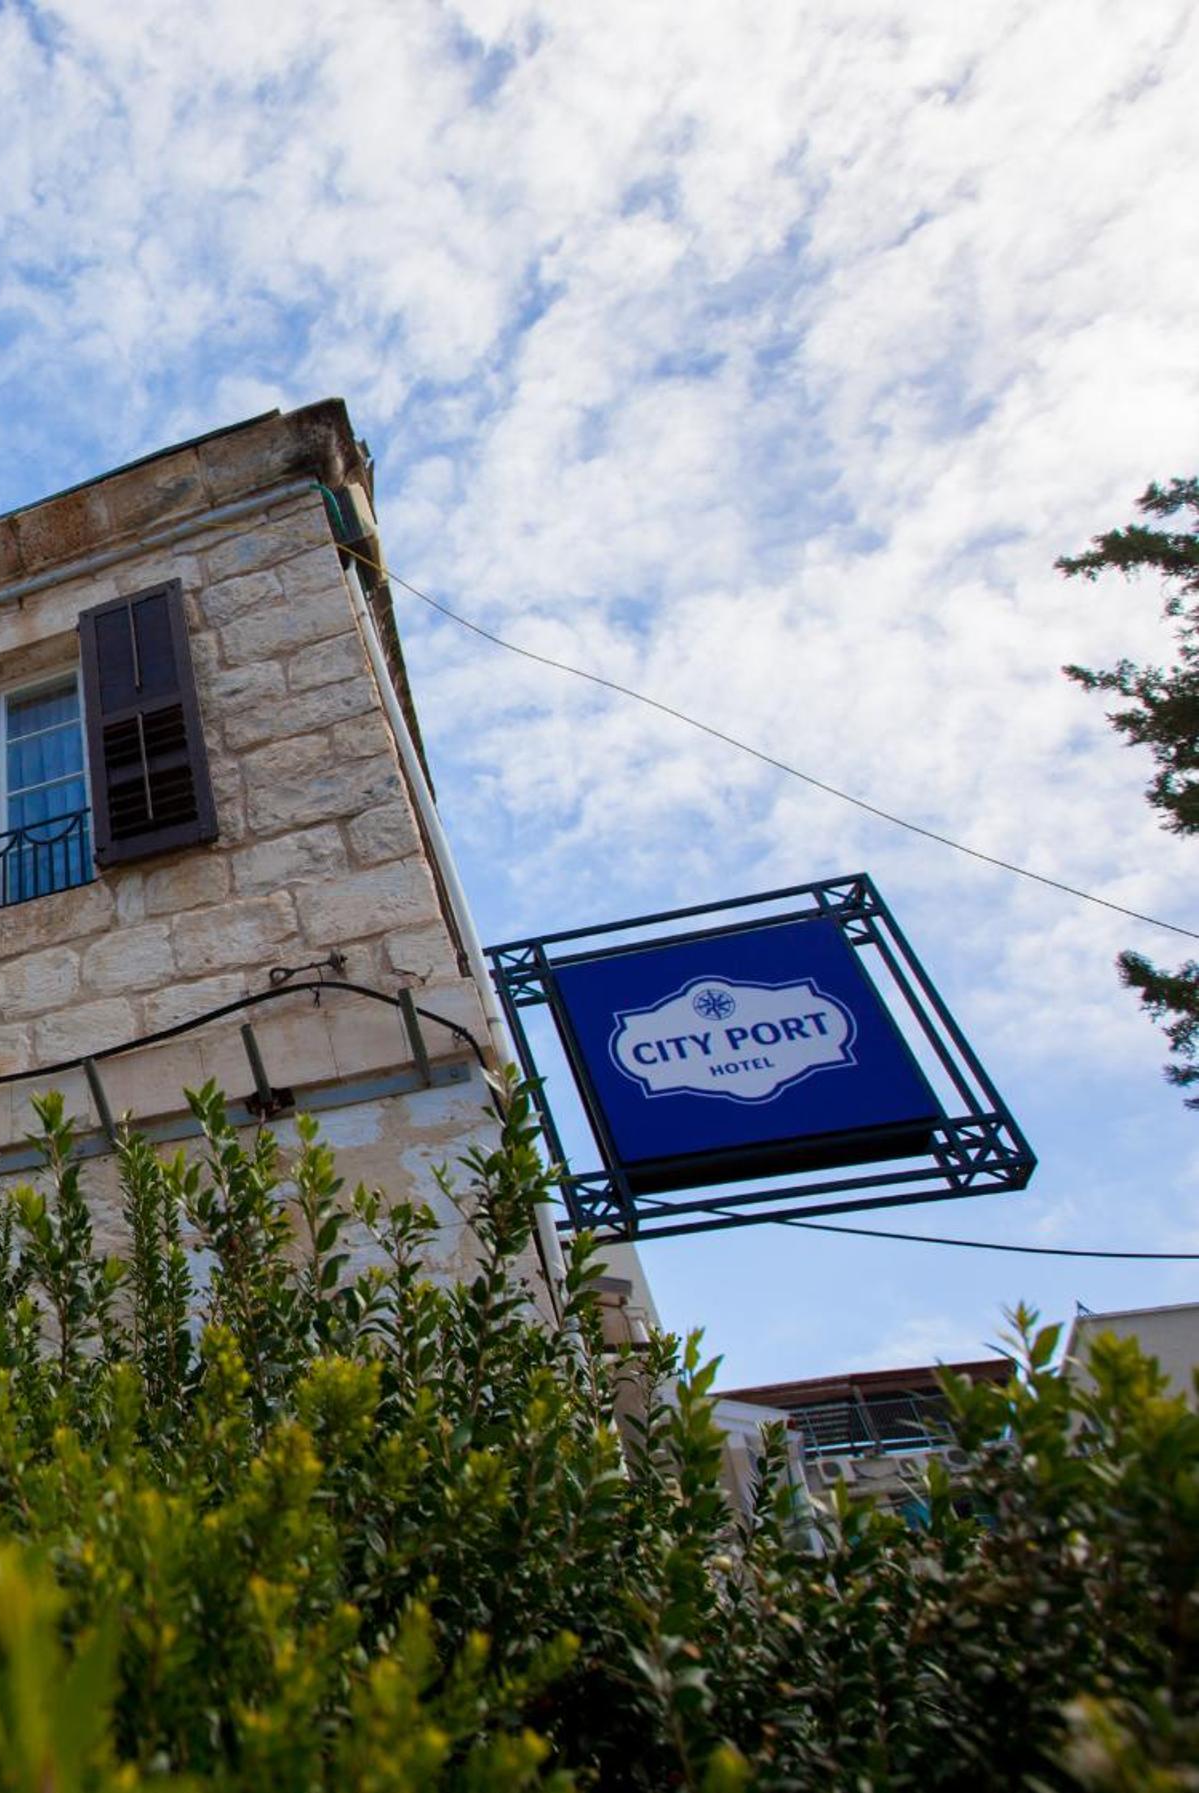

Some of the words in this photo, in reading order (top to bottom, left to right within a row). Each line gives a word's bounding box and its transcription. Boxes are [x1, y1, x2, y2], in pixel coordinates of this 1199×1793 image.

[632, 1032, 712, 1065] CITY
[725, 1012, 829, 1050] PORT
[709, 1057, 775, 1077] HOTEL
